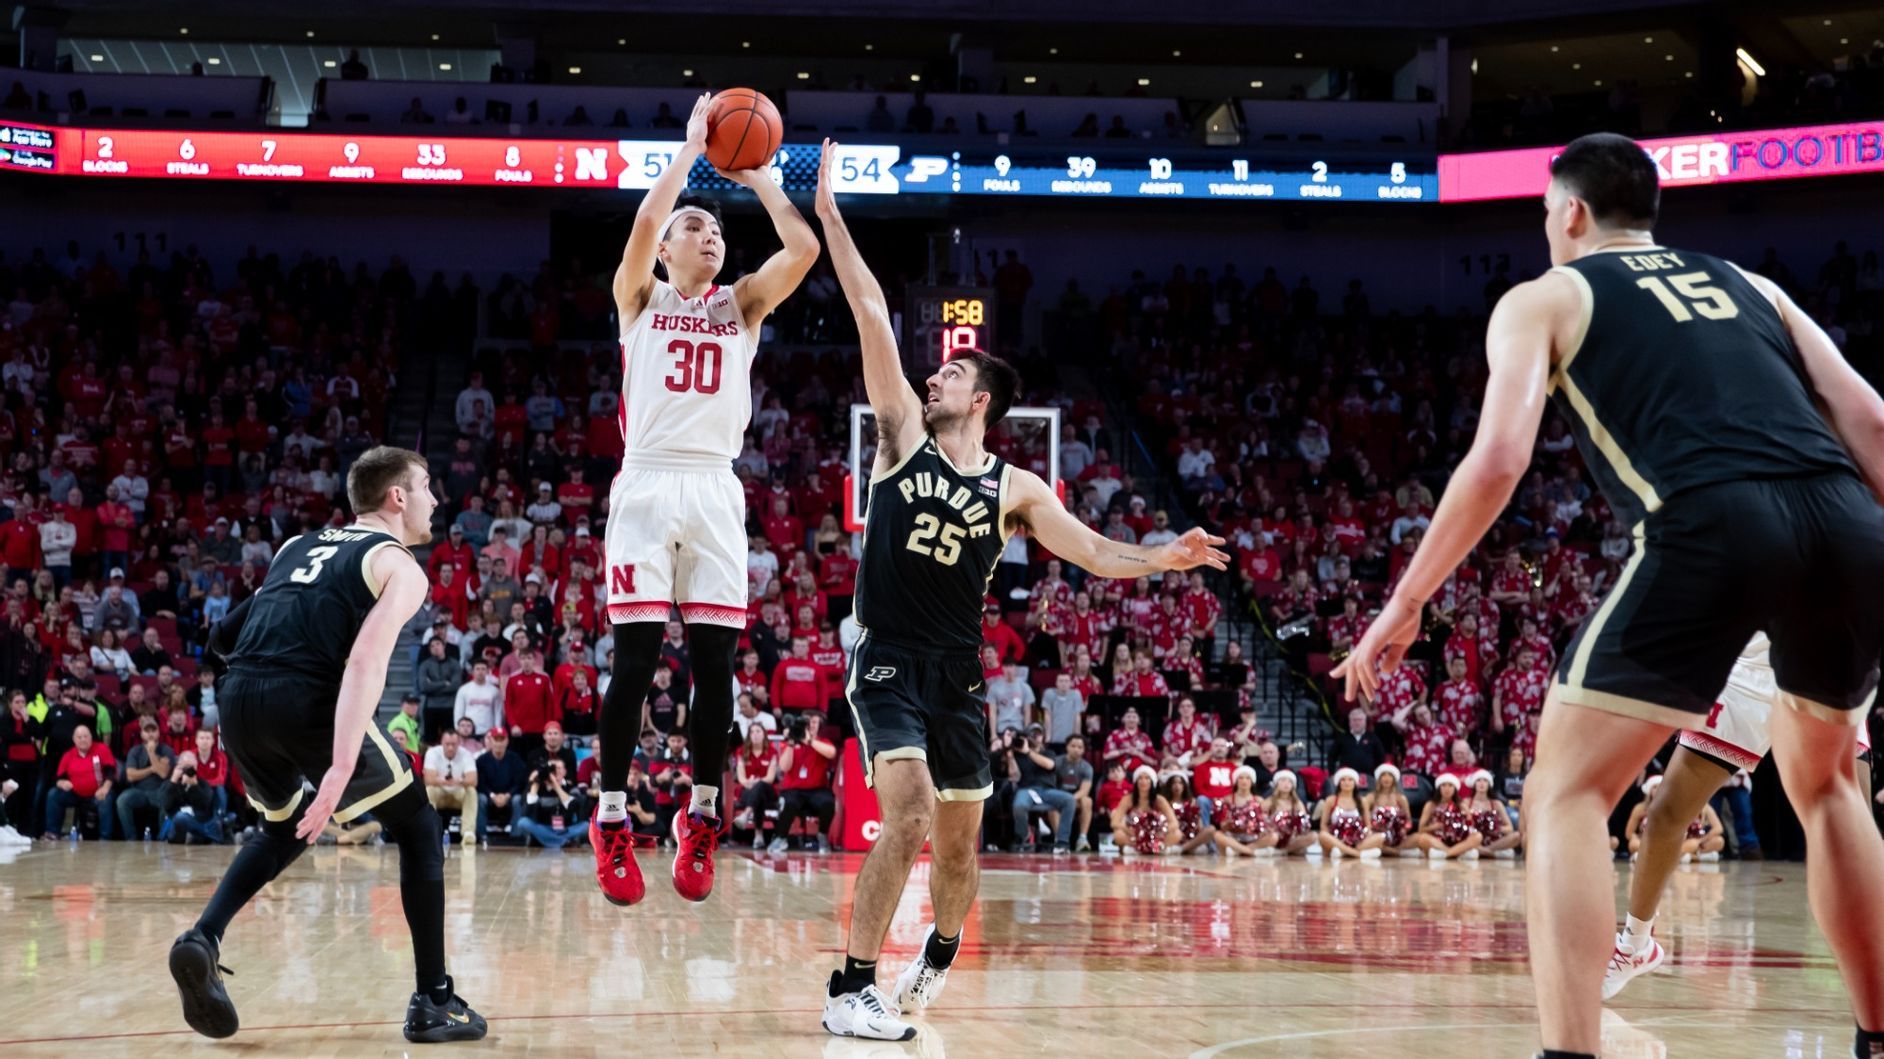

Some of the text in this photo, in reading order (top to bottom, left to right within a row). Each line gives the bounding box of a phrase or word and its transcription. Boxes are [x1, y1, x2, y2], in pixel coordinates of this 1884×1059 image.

[97, 136, 114, 158] 2
[178, 138, 196, 160] 6
[261, 139, 277, 162] 7
[343, 142, 360, 164] 9
[416, 144, 447, 166] 33
[504, 146, 521, 168] 8
[82, 160, 128, 174] BLOCKS
[166, 161, 210, 175] STEALS
[236, 163, 304, 177] TURNOVERS
[329, 166, 375, 179] ASSISTS
[401, 167, 463, 180] REBOUNDS
[494, 169, 532, 182] FOULS
[575, 148, 609, 181] N
[841, 157, 882, 183] 54
[904, 157, 949, 183] P
[994, 155, 1011, 177] 9
[1067, 156, 1097, 179] 39
[1149, 158, 1173, 180] 10
[1232, 159, 1249, 182] 11
[1311, 160, 1328, 183] 2
[1390, 162, 1407, 184] 5
[983, 178, 1020, 192] FOULS
[1051, 180, 1112, 193] REBOUNDS
[1138, 182, 1184, 195] ASSISTS
[1208, 183, 1274, 197] TURNOVERS
[1299, 184, 1342, 198] STEALS
[1377, 186, 1422, 199] BLOCKS
[1620, 252, 1686, 272] EDEY
[1636, 271, 1739, 323] 15
[943, 299, 984, 326] 1:58
[651, 313, 738, 337] HUSKERS
[665, 339, 722, 395] 30
[898, 471, 991, 539] PURDUE
[906, 512, 968, 567] 25
[290, 545, 339, 584] 3
[612, 564, 635, 595] N
[864, 666, 897, 682] P
[1209, 766, 1232, 787] N
